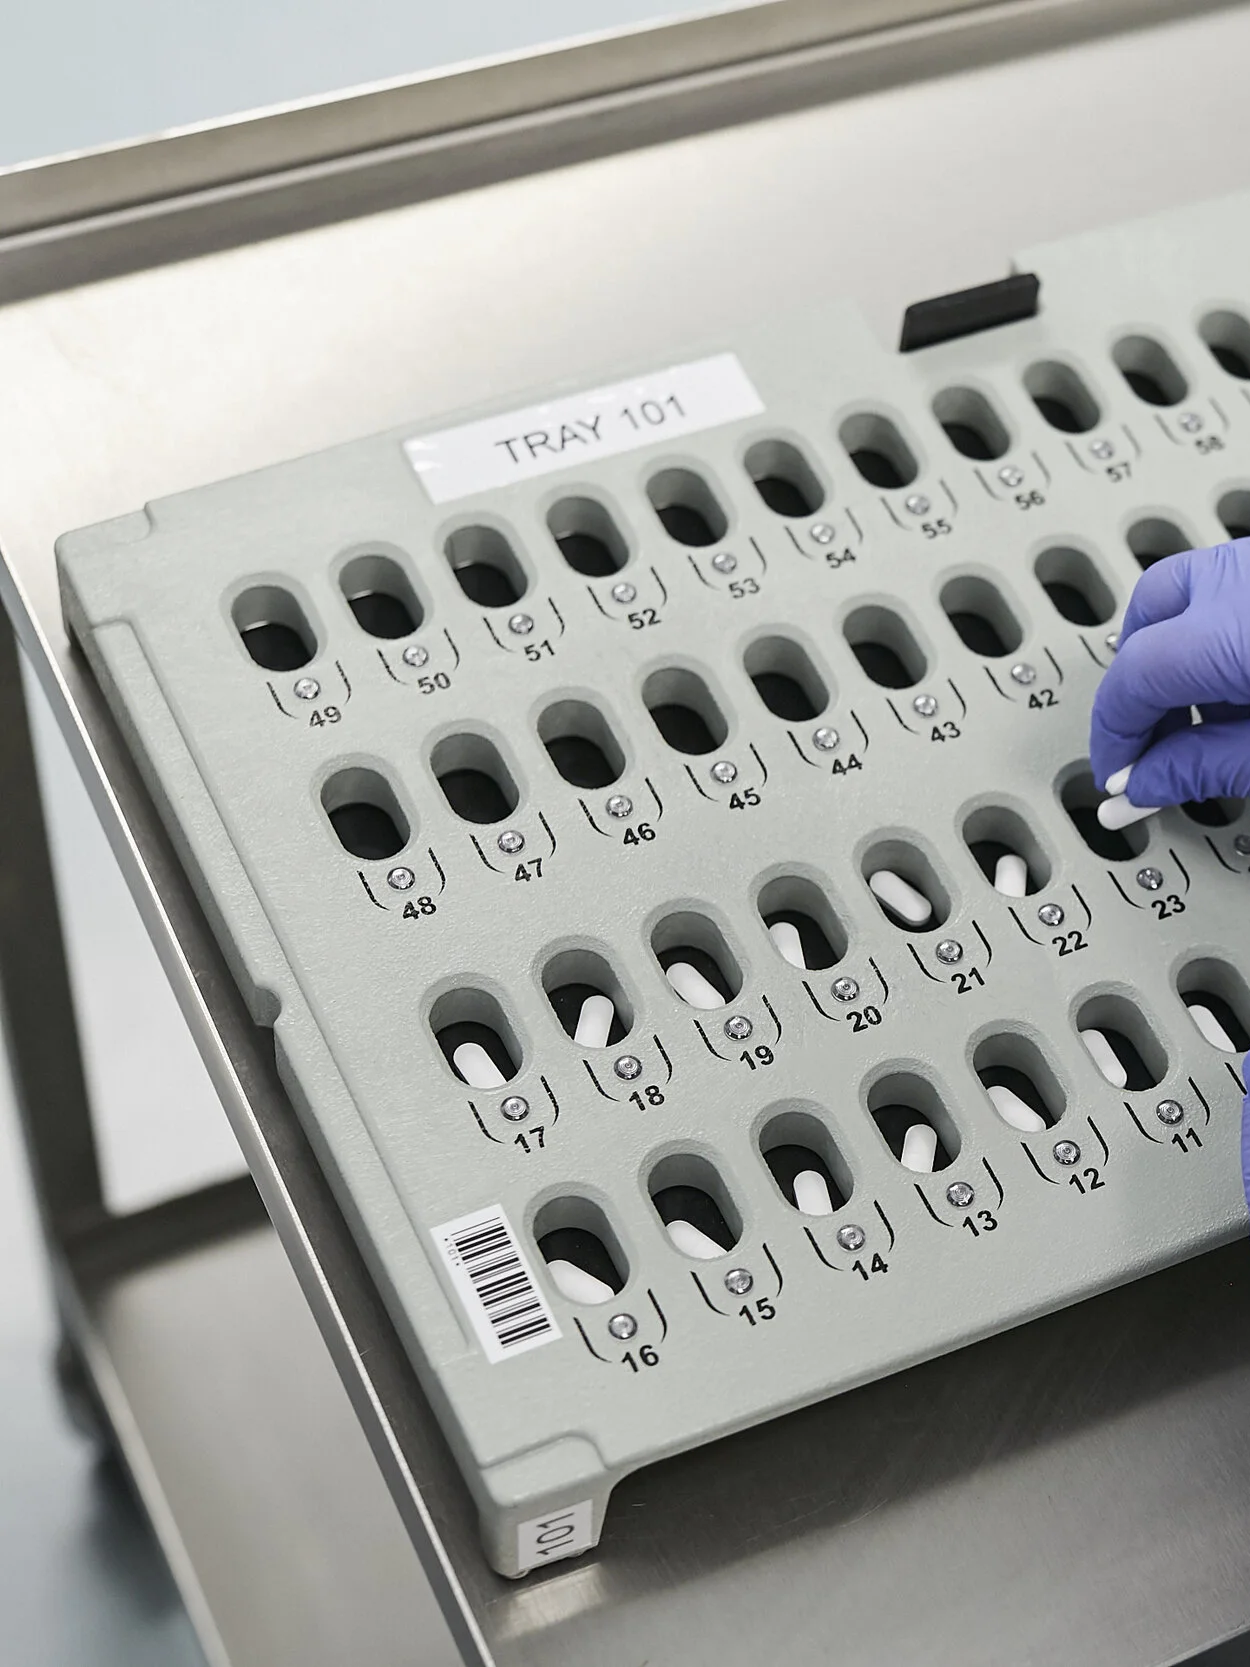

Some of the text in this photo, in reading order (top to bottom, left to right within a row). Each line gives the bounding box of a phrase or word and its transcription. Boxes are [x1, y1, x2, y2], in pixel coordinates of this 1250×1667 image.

[495, 394, 686, 464] TRAY 101
[1105, 461, 1132, 483] 57
[1014, 489, 1046, 511] 56
[921, 518, 953, 540] 55
[825, 547, 857, 569] 54
[728, 577, 761, 600] 53
[627, 608, 662, 630] 52
[523, 639, 555, 662] 51
[417, 672, 451, 695] 50
[1028, 688, 1060, 710] 42
[309, 706, 342, 728] 49
[930, 721, 961, 743] 43
[831, 753, 863, 776] 44
[729, 786, 762, 810] 45
[623, 822, 656, 846] 46
[514, 857, 543, 882] 47
[402, 896, 437, 920] 48
[1150, 894, 1186, 921] 23
[1051, 930, 1089, 957] 22
[950, 966, 986, 995] 21
[845, 1005, 883, 1033] 20
[739, 1045, 775, 1071] 19
[628, 1084, 665, 1112] 18
[513, 1125, 545, 1154] 17
[1171, 1127, 1203, 1154] 11
[1068, 1167, 1106, 1195] 12
[962, 1209, 998, 1238] 13
[851, 1252, 889, 1281] 14
[738, 1296, 776, 1327] 15
[621, 1344, 660, 1373] 16
[536, 1512, 575, 1556] 101
